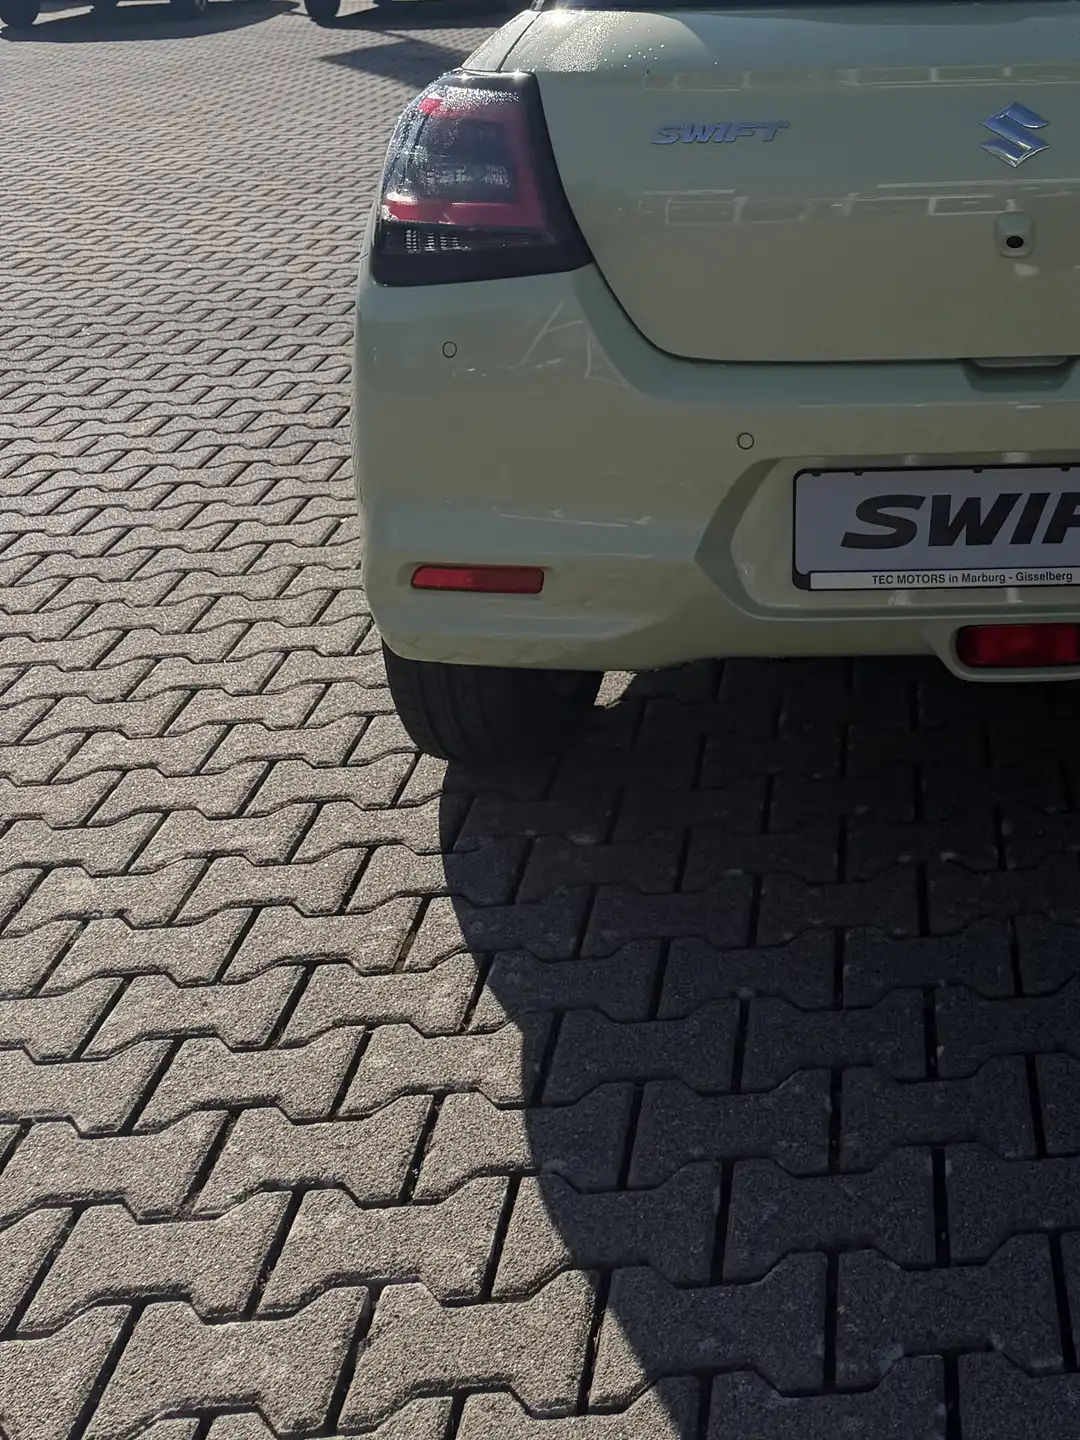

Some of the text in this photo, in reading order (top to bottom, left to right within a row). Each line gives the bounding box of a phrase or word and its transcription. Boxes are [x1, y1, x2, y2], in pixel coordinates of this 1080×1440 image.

[650, 120, 791, 145] SWIFT
[872, 574, 893, 585] TEC
[897, 573, 946, 584] MOTORS
[949, 573, 959, 583] in
[961, 572, 1006, 584] Marburg
[1015, 570, 1073, 582] Gisselberg
